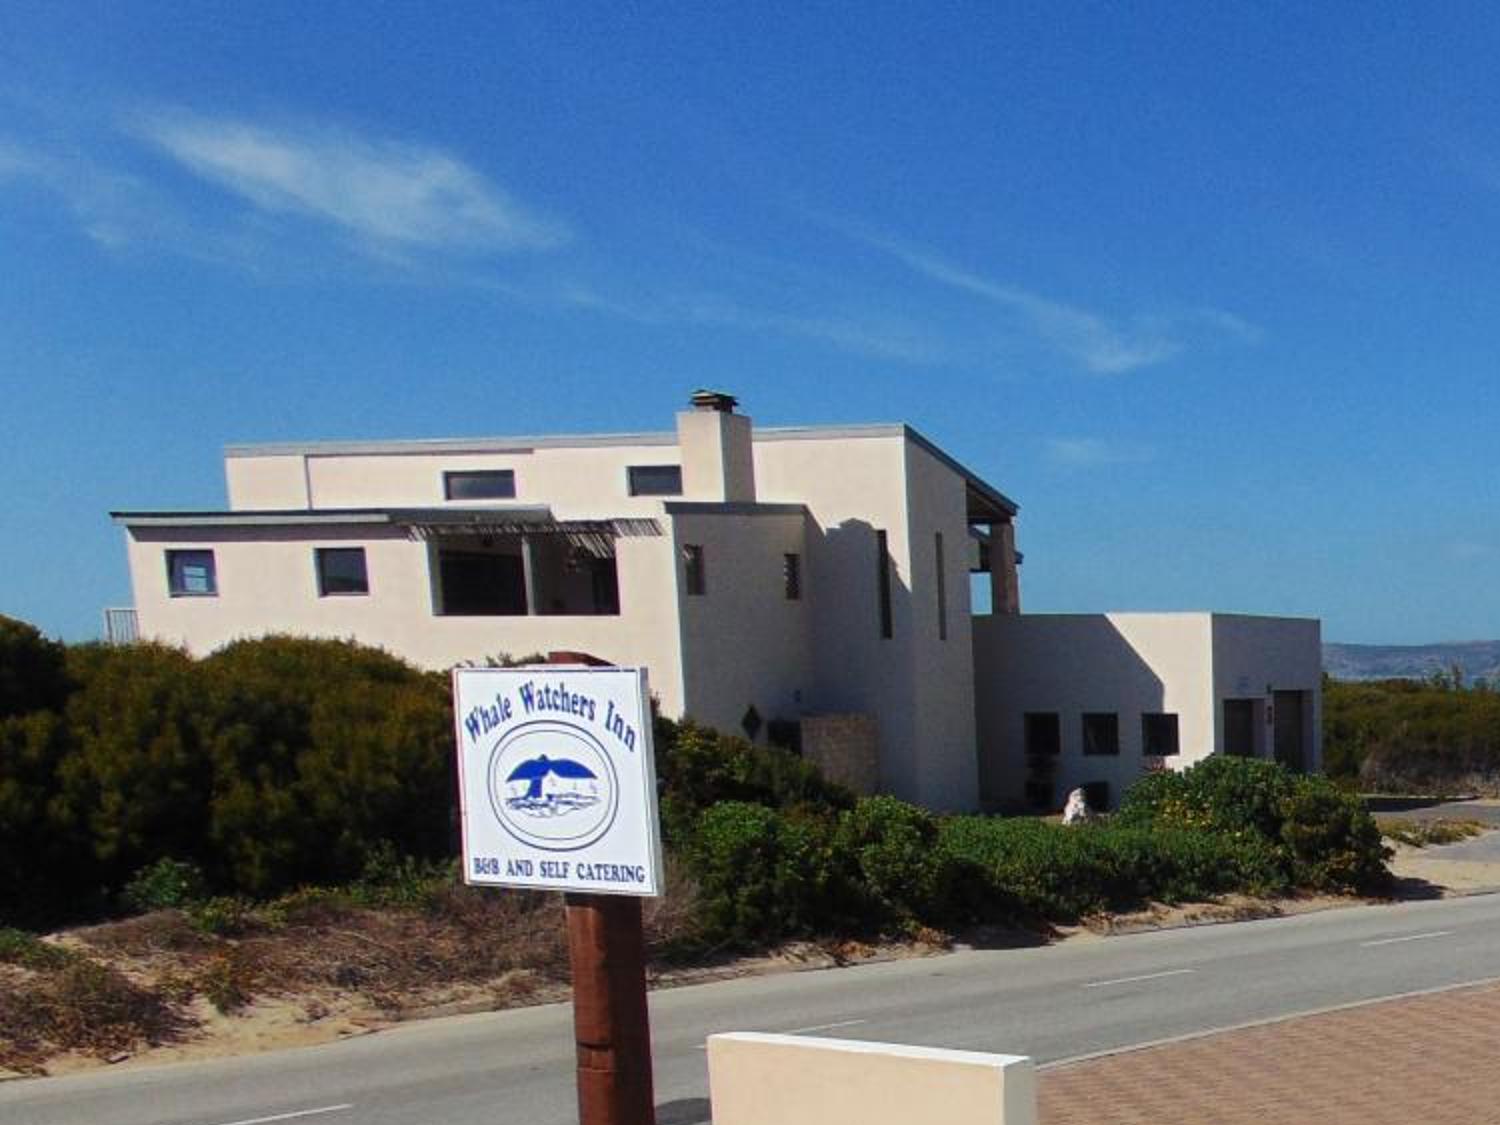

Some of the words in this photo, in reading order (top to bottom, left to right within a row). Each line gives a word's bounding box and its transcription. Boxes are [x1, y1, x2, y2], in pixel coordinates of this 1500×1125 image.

[464, 693, 513, 744] Whale
[519, 680, 595, 721] Watchers
[606, 700, 637, 752] Inn
[473, 857, 500, 875] B&B
[507, 859, 533, 877] AND
[539, 861, 570, 879] SELF
[576, 863, 645, 883] CATERING
